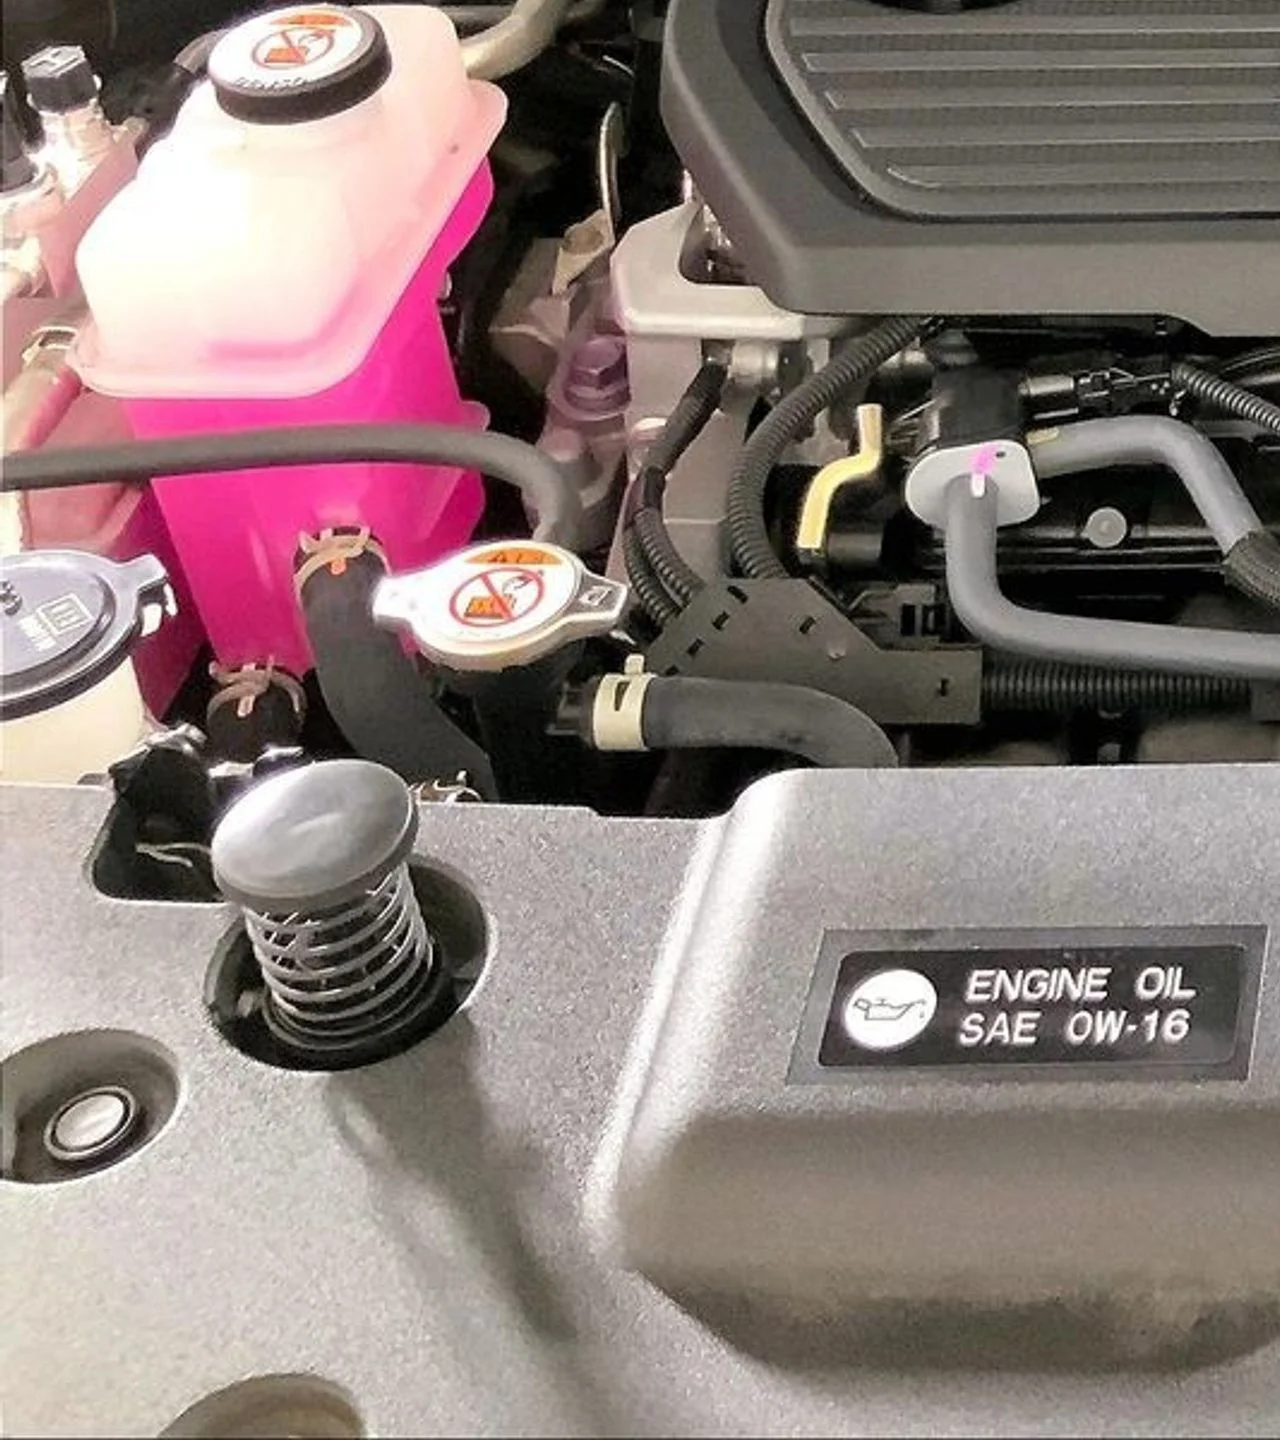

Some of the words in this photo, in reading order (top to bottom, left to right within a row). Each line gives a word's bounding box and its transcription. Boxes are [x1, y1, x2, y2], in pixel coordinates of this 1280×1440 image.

[965, 967, 1112, 1003] ENGINE
[1135, 966, 1197, 1000] OIL
[959, 1010, 1042, 1047] SAE
